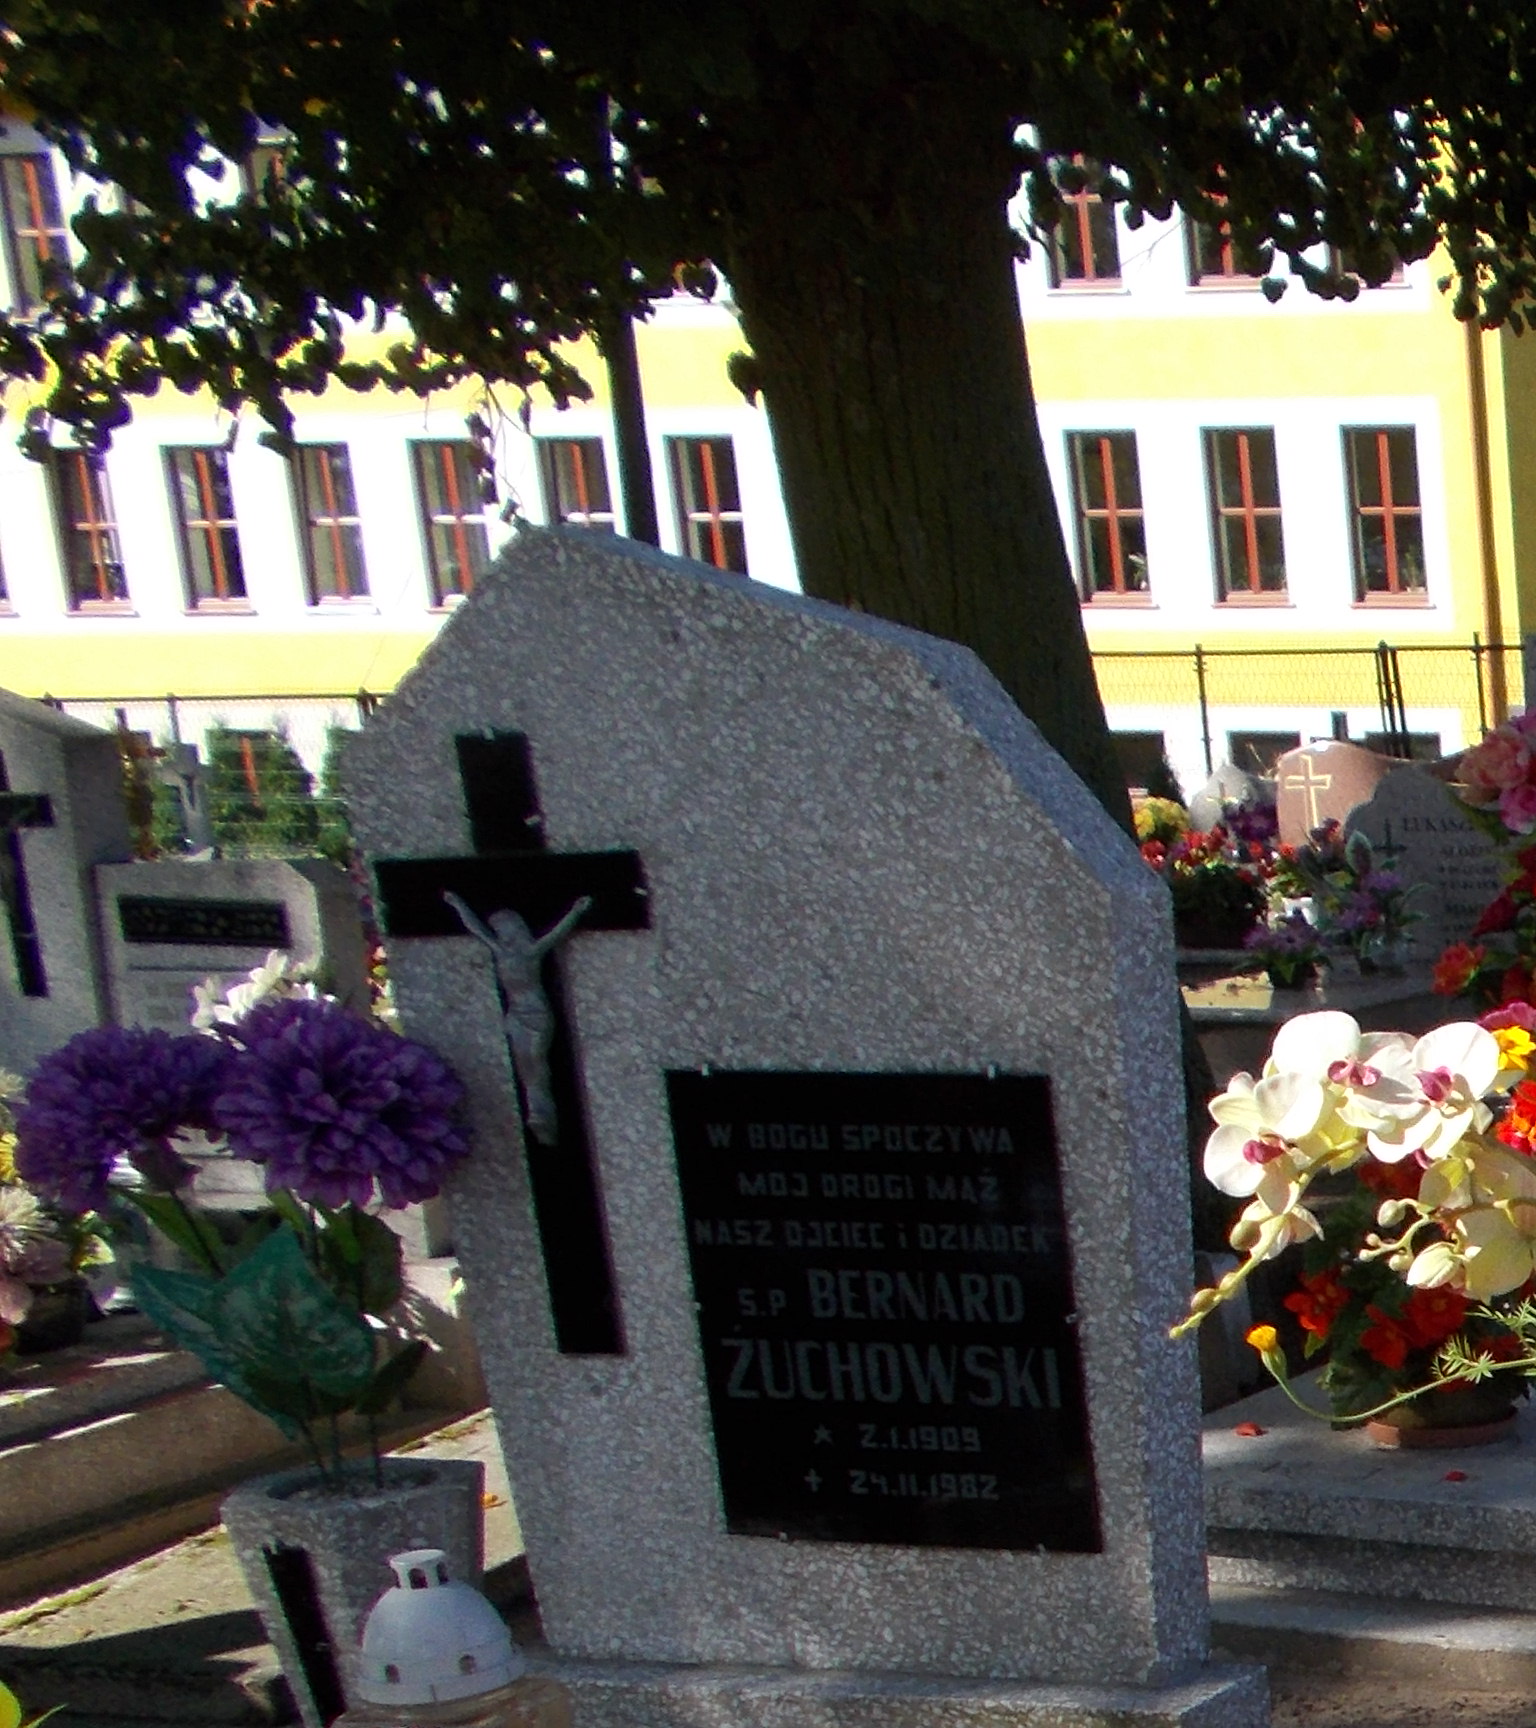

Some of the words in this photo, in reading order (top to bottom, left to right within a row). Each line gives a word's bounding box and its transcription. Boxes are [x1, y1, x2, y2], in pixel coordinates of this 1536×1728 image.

[706, 1123, 734, 1150] W
[747, 1123, 831, 1151] BOGU
[840, 1124, 1016, 1155] SPOCZYWA
[820, 1172, 915, 1201] DROGI
[694, 1219, 774, 1247] NASZ
[785, 1221, 886, 1250] OJCIEC
[918, 1223, 1051, 1254] DZIADEK
[806, 1268, 1026, 1325] BERNARD
[720, 1322, 1063, 1409] ŻUCHOWSKI
